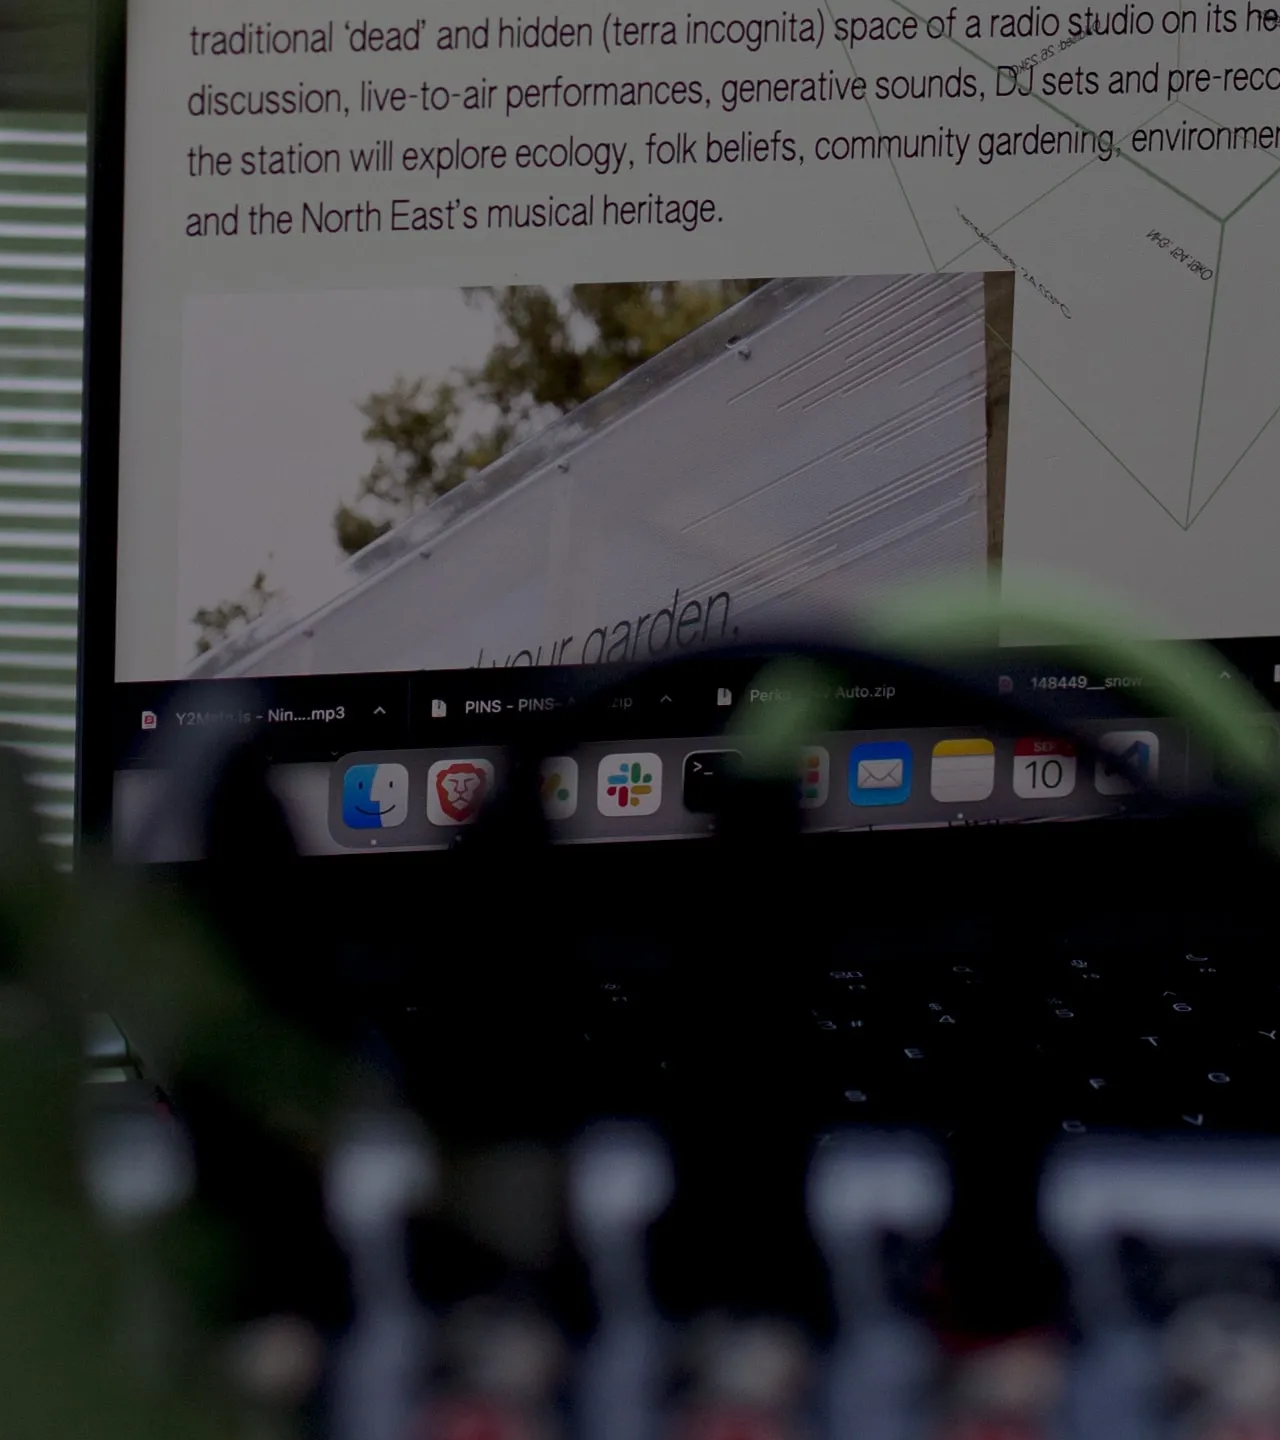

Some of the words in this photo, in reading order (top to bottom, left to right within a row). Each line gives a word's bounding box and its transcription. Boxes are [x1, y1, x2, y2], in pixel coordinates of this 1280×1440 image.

[189, 20, 334, 56] traditional
[437, 17, 489, 50] and
[498, 15, 594, 49] hidden
[602, 13, 678, 54] (terra
[686, 7, 826, 52] incognita)
[833, 15, 919, 50] space
[926, 6, 959, 40] of
[965, 14, 982, 39] a
[989, 4, 1060, 38] radio
[1067, 2, 1156, 37] studio
[1161, 11, 1198, 35] on
[1206, 1, 1237, 34] its
[187, 81, 351, 118] discussion,
[361, 77, 499, 112] live-to-air
[506, 75, 711, 117] performances,
[721, 69, 868, 113] generative
[875, 66, 986, 103] sounds,
[995, 65, 1035, 98] DJ
[1042, 65, 1100, 97] sets
[1108, 62, 1160, 95] and
[187, 145, 232, 177] the
[241, 142, 340, 176] station
[349, 140, 393, 172] will
[402, 138, 507, 179] explore
[515, 135, 634, 175] ecology,
[645, 132, 697, 165] folk
[706, 129, 804, 166] beliefs,
[814, 125, 971, 166] community
[978, 119, 1122, 161] gardening,
[185, 203, 239, 237] and
[248, 203, 293, 236] the
[302, 200, 381, 234] North
[487, 194, 594, 229] musical
[603, 192, 723, 232] heritage.
[464, 700, 503, 714] PINS
[1024, 759, 1063, 789] 10
